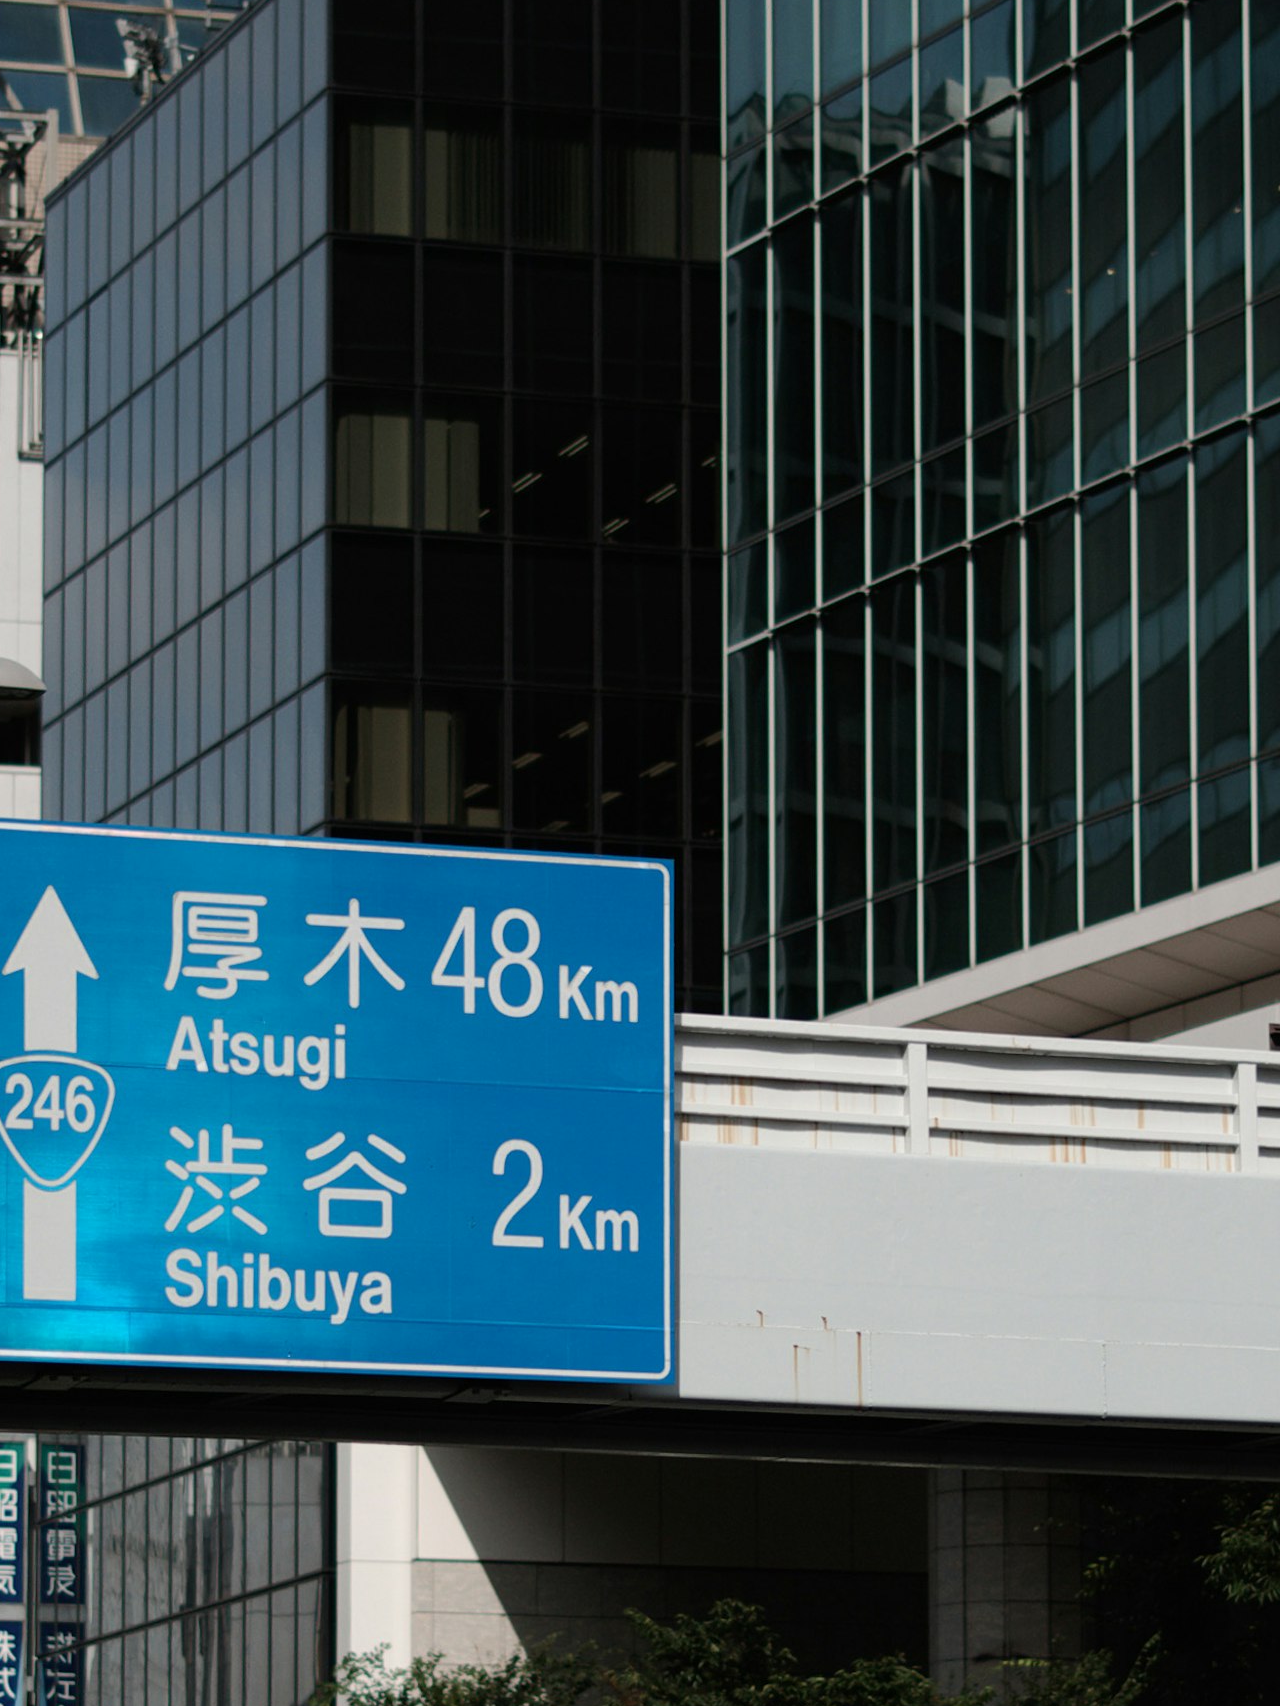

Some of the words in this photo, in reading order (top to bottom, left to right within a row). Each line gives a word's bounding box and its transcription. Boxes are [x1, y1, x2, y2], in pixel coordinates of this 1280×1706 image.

[163, 890, 406, 1009] 厚木
[431, 906, 543, 1018] 48
[558, 964, 640, 1024] Km
[165, 1015, 347, 1090] Atsugi
[3, 1073, 96, 1133] 246
[164, 1123, 407, 1239] 渋谷
[491, 1139, 545, 1249] 2
[558, 1195, 640, 1253] Km
[164, 1248, 394, 1326] Shibuya
